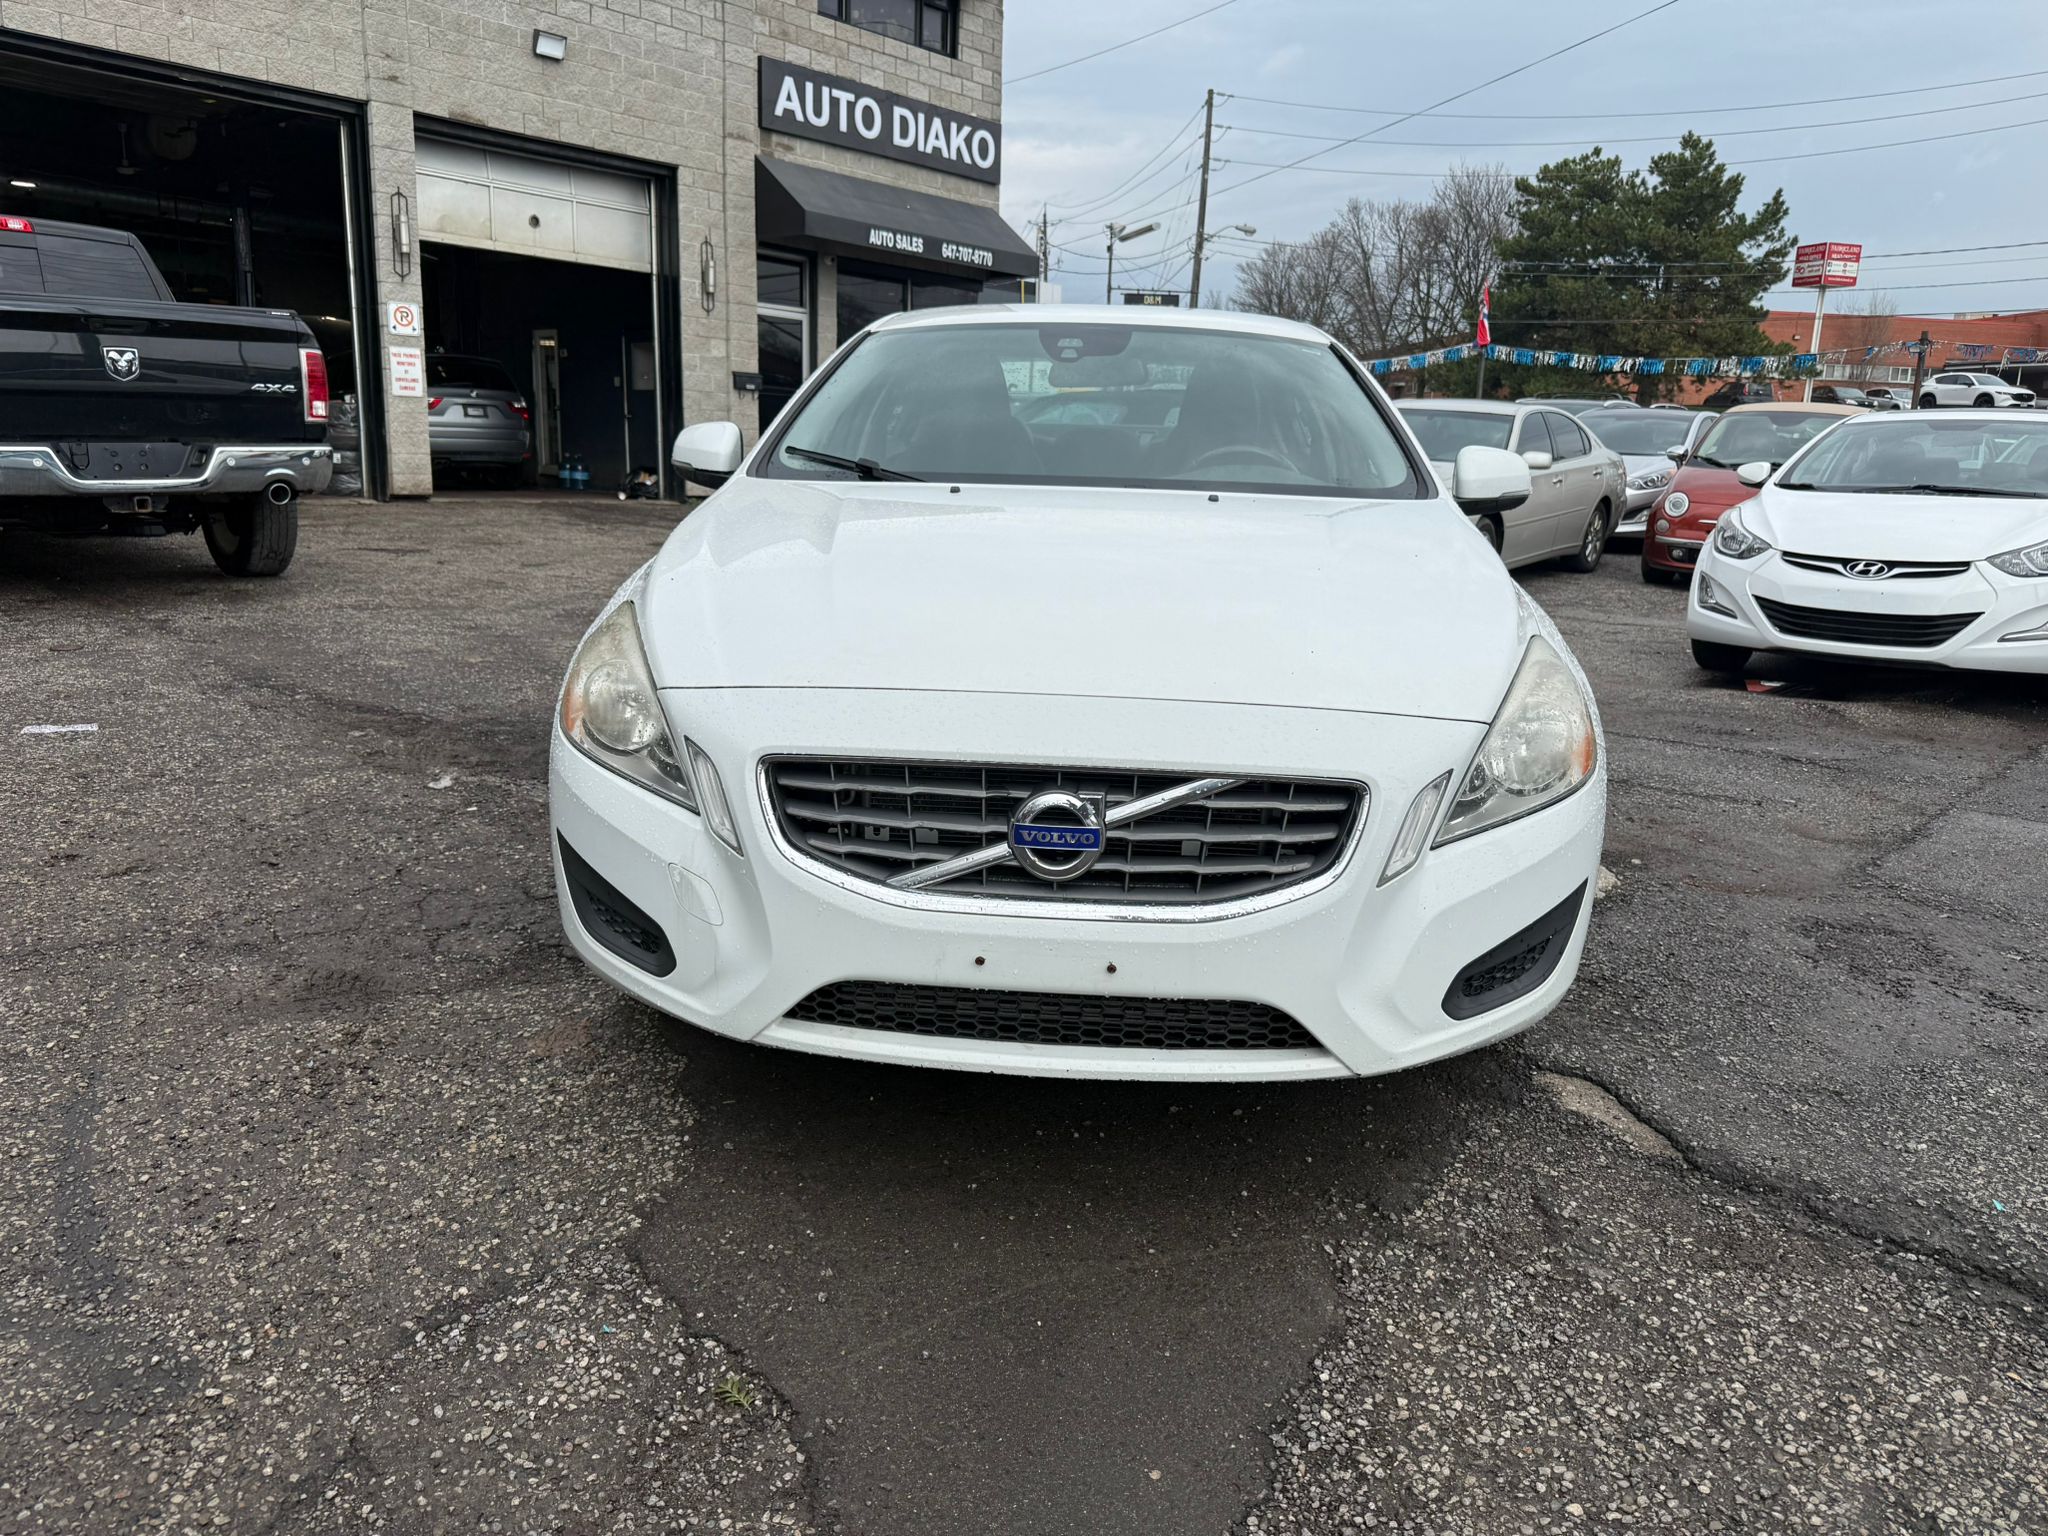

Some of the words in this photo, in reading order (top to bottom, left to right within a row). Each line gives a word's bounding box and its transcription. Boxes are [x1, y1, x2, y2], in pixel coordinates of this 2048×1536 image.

[774, 75, 882, 140] AUTO
[892, 105, 996, 170] DIAKO
[869, 228, 895, 248] AUTO
[895, 233, 924, 253] SALES
[941, 242, 993, 267] 647-707-8770
[1018, 829, 1096, 845] VOLVO
